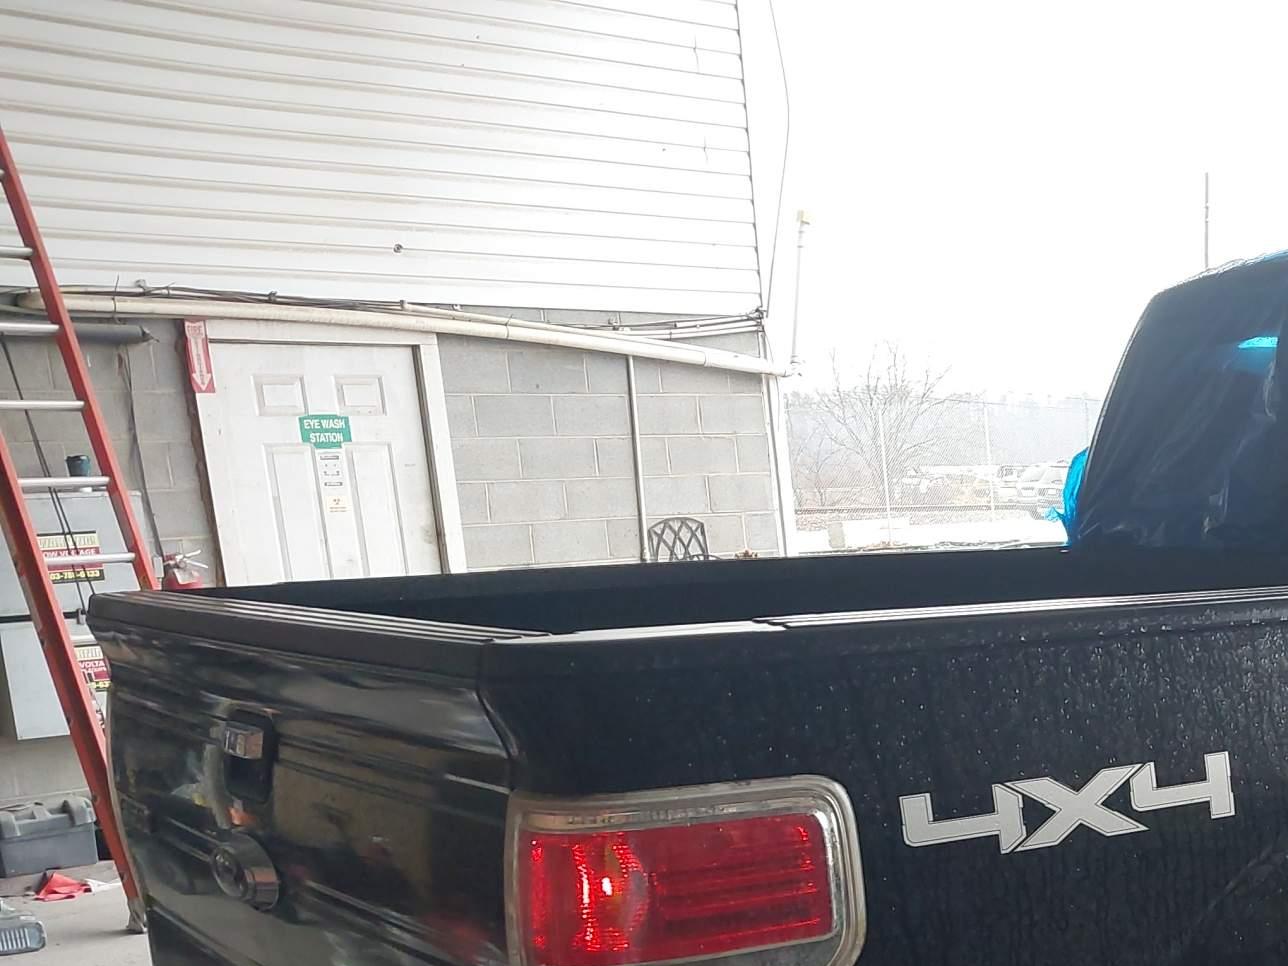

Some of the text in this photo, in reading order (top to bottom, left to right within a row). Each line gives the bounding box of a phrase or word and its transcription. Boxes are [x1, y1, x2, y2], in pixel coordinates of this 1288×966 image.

[303, 418, 345, 430] EYE WASH
[309, 431, 344, 443] STATION
[80, 660, 106, 669] VOLTA
